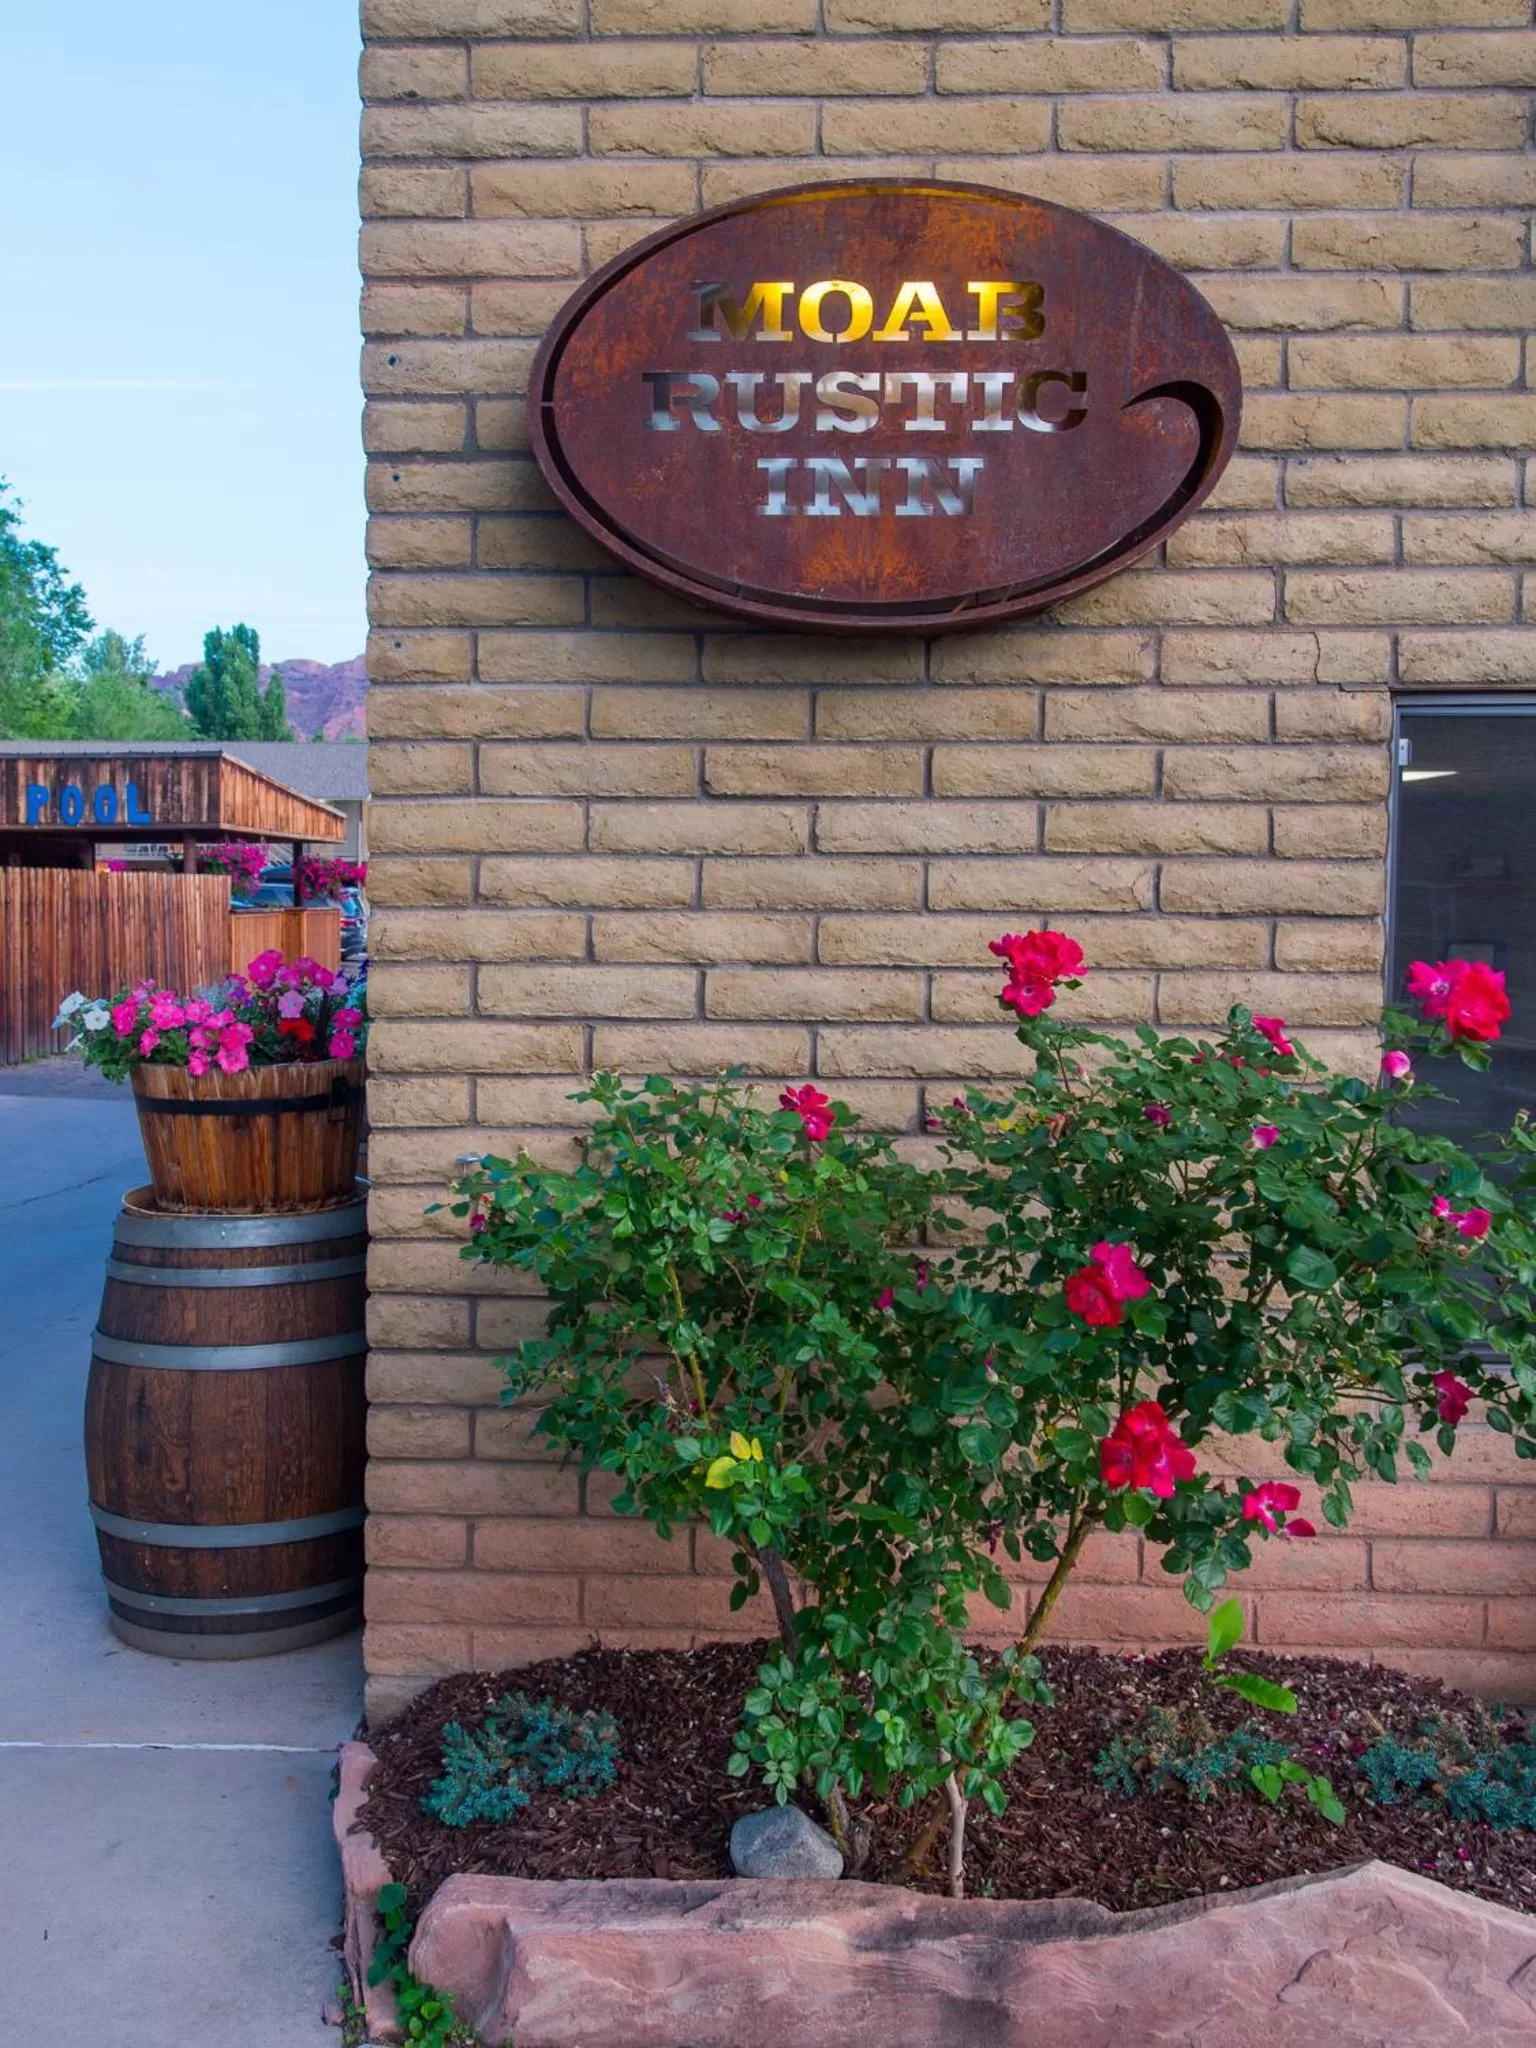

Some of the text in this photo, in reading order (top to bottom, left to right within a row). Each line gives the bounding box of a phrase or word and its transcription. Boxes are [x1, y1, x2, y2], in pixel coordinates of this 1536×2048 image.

[687, 280, 1046, 344] MOAB
[642, 371, 1089, 434] RUSTIC
[756, 457, 985, 517] INN
[27, 784, 150, 826] POOL
